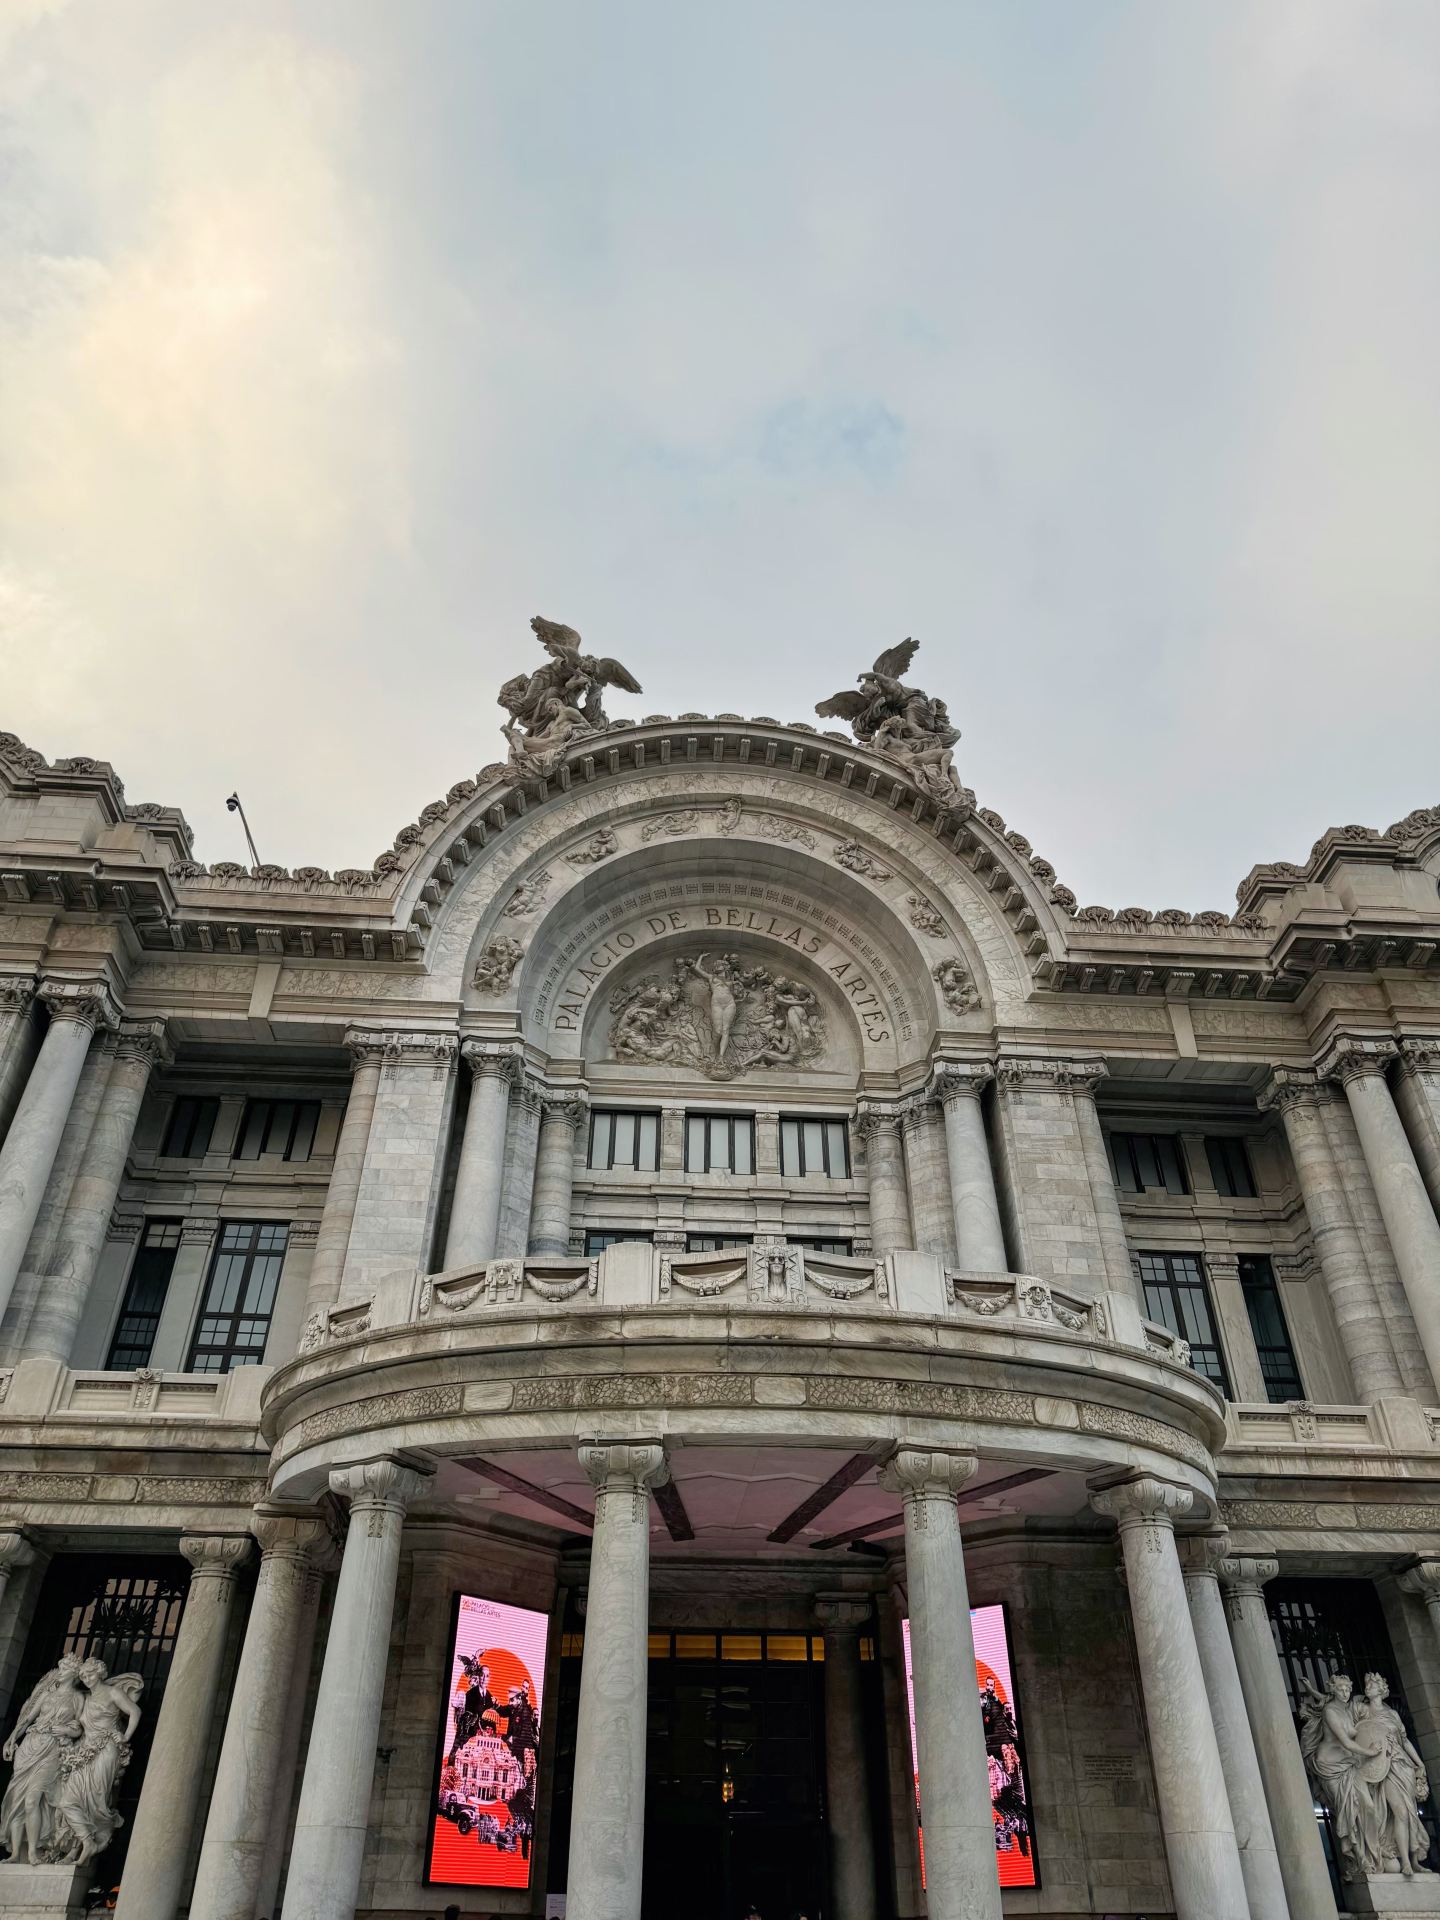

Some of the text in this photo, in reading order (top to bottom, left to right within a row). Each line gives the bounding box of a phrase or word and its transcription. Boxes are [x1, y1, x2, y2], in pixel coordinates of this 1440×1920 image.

[555, 908, 889, 1043] PALACIO DE BELLAS ARTES
